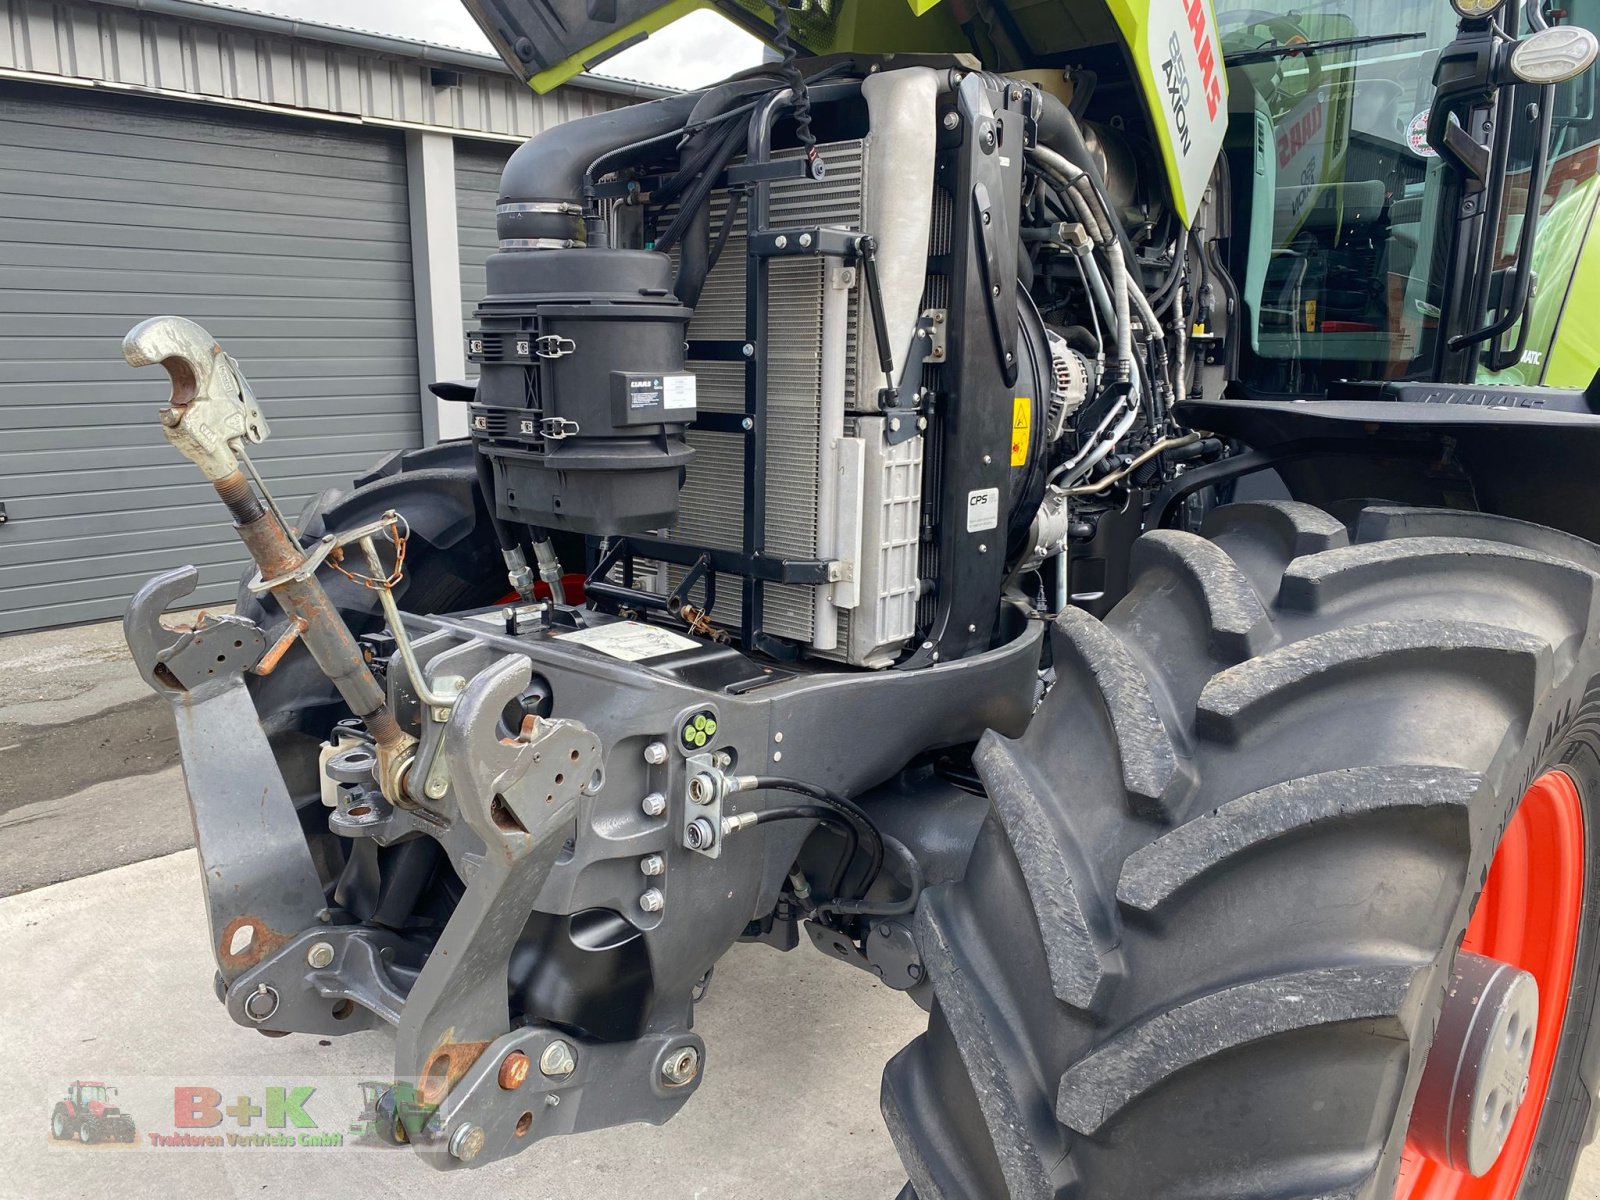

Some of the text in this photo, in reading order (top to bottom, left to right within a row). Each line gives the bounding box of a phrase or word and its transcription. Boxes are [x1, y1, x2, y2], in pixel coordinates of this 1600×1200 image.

[1168, 30, 1190, 107] 850
[1161, 59, 1191, 158] AXION
[970, 494, 988, 506] CPS
